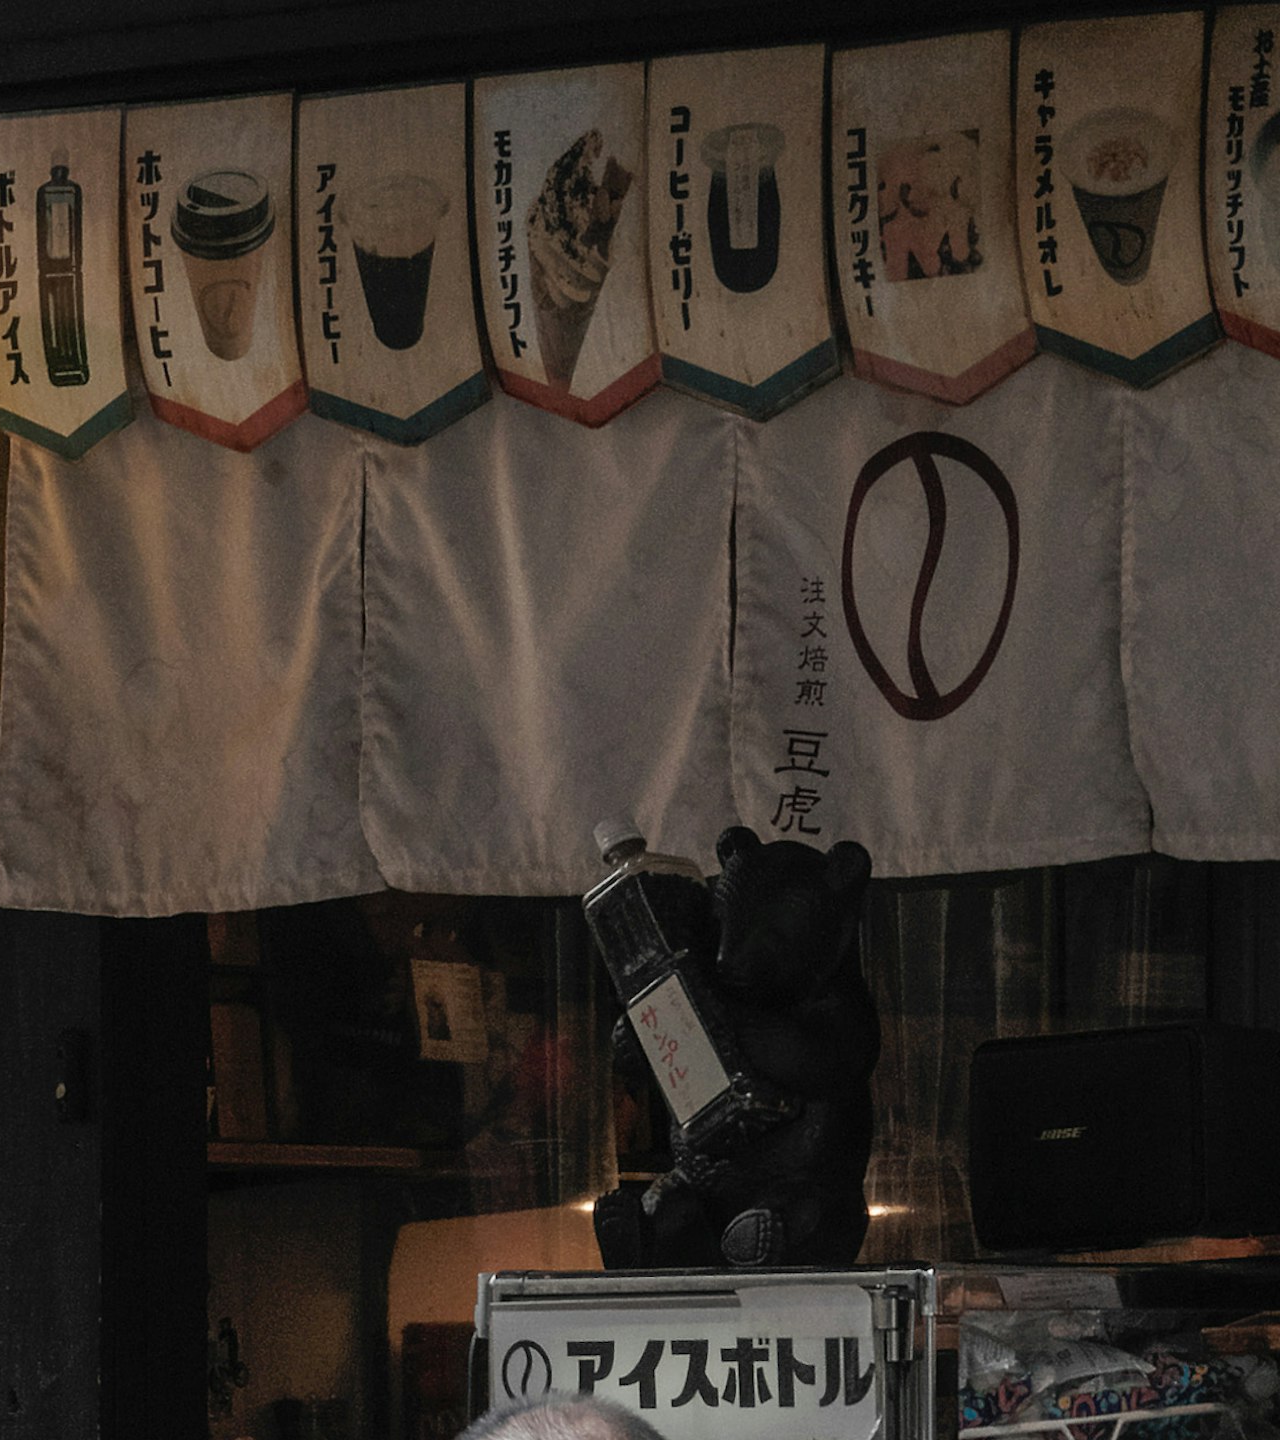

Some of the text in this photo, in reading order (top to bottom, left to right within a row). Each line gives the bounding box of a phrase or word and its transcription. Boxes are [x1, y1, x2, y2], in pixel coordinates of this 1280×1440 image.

[137, 151, 172, 388] ホットコーヒー
[317, 164, 340, 364] アイスコーヒー
[669, 106, 692, 331] コーヒーゼリー
[1034, 69, 1062, 297] キャラメルオレ
[796, 577, 828, 706] 注文焙煎
[771, 729, 830, 835] 豆虎
[567, 1337, 875, 1408] アイスボトル
